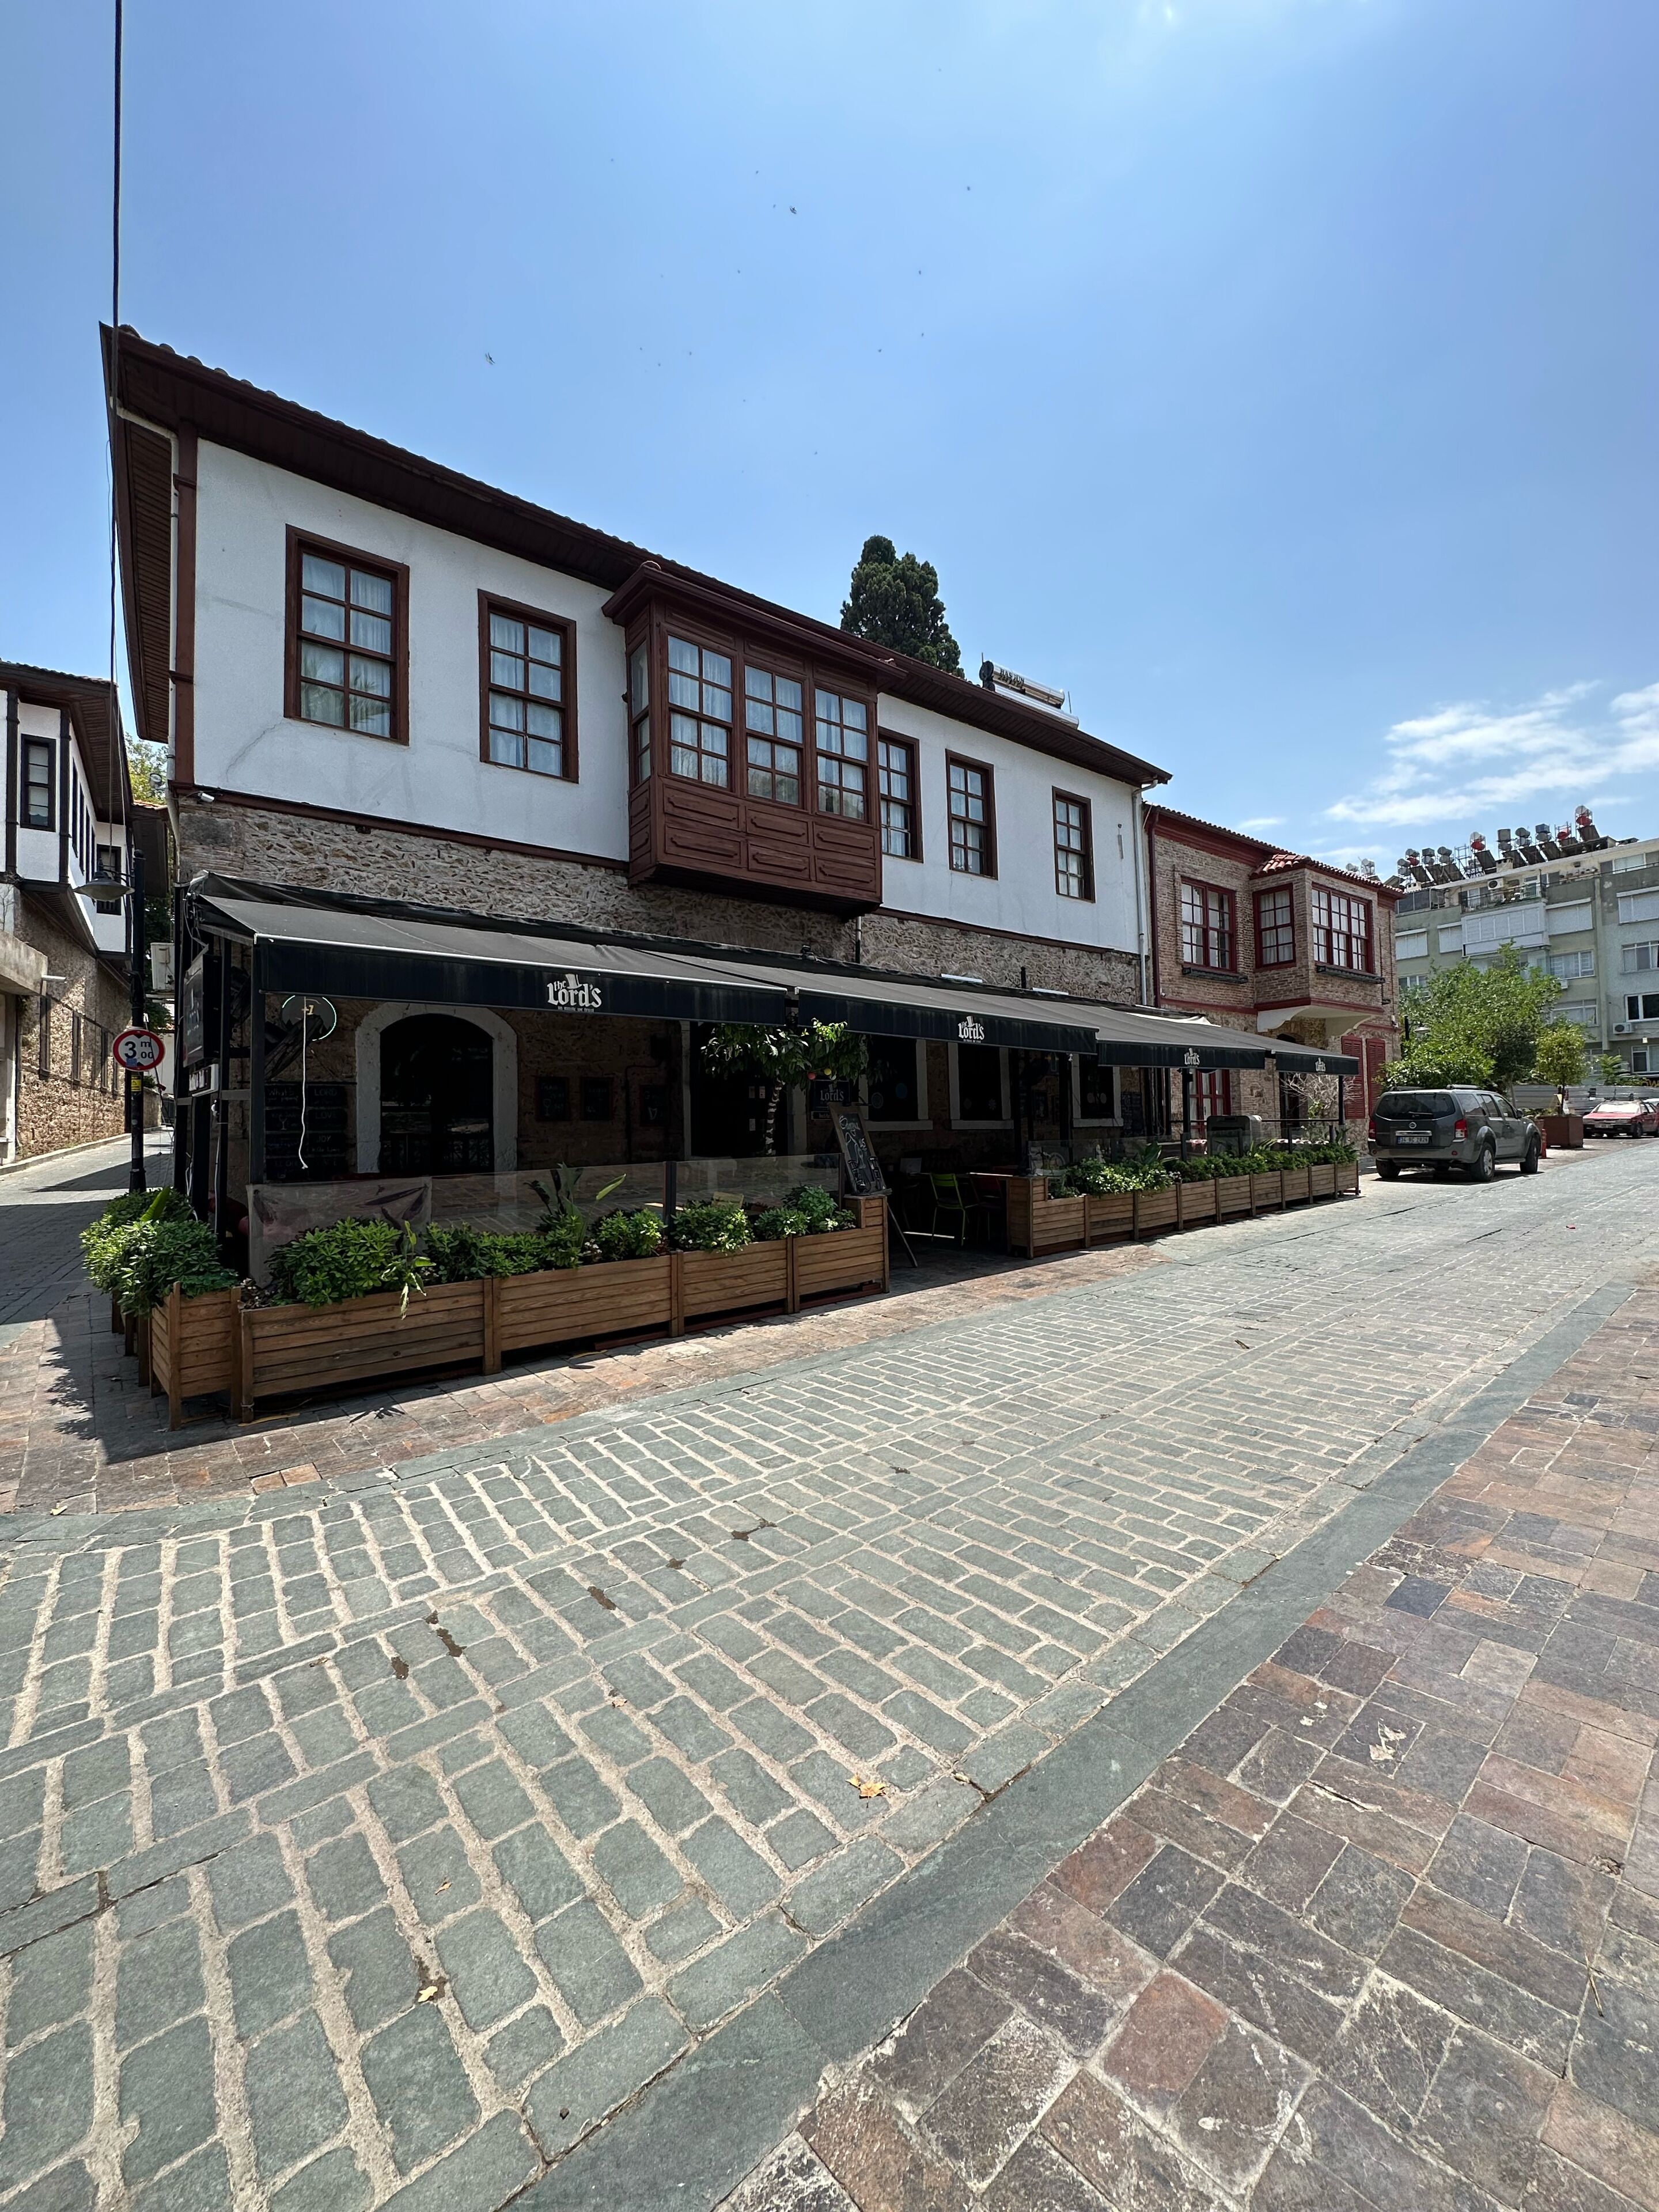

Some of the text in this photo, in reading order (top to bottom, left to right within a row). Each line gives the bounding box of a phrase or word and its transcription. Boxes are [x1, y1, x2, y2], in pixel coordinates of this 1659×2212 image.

[554, 980, 567, 991] the
[547, 983, 601, 1007] Lord's
[958, 1022, 984, 1040] Lord's
[124, 1041, 137, 1059] 3
